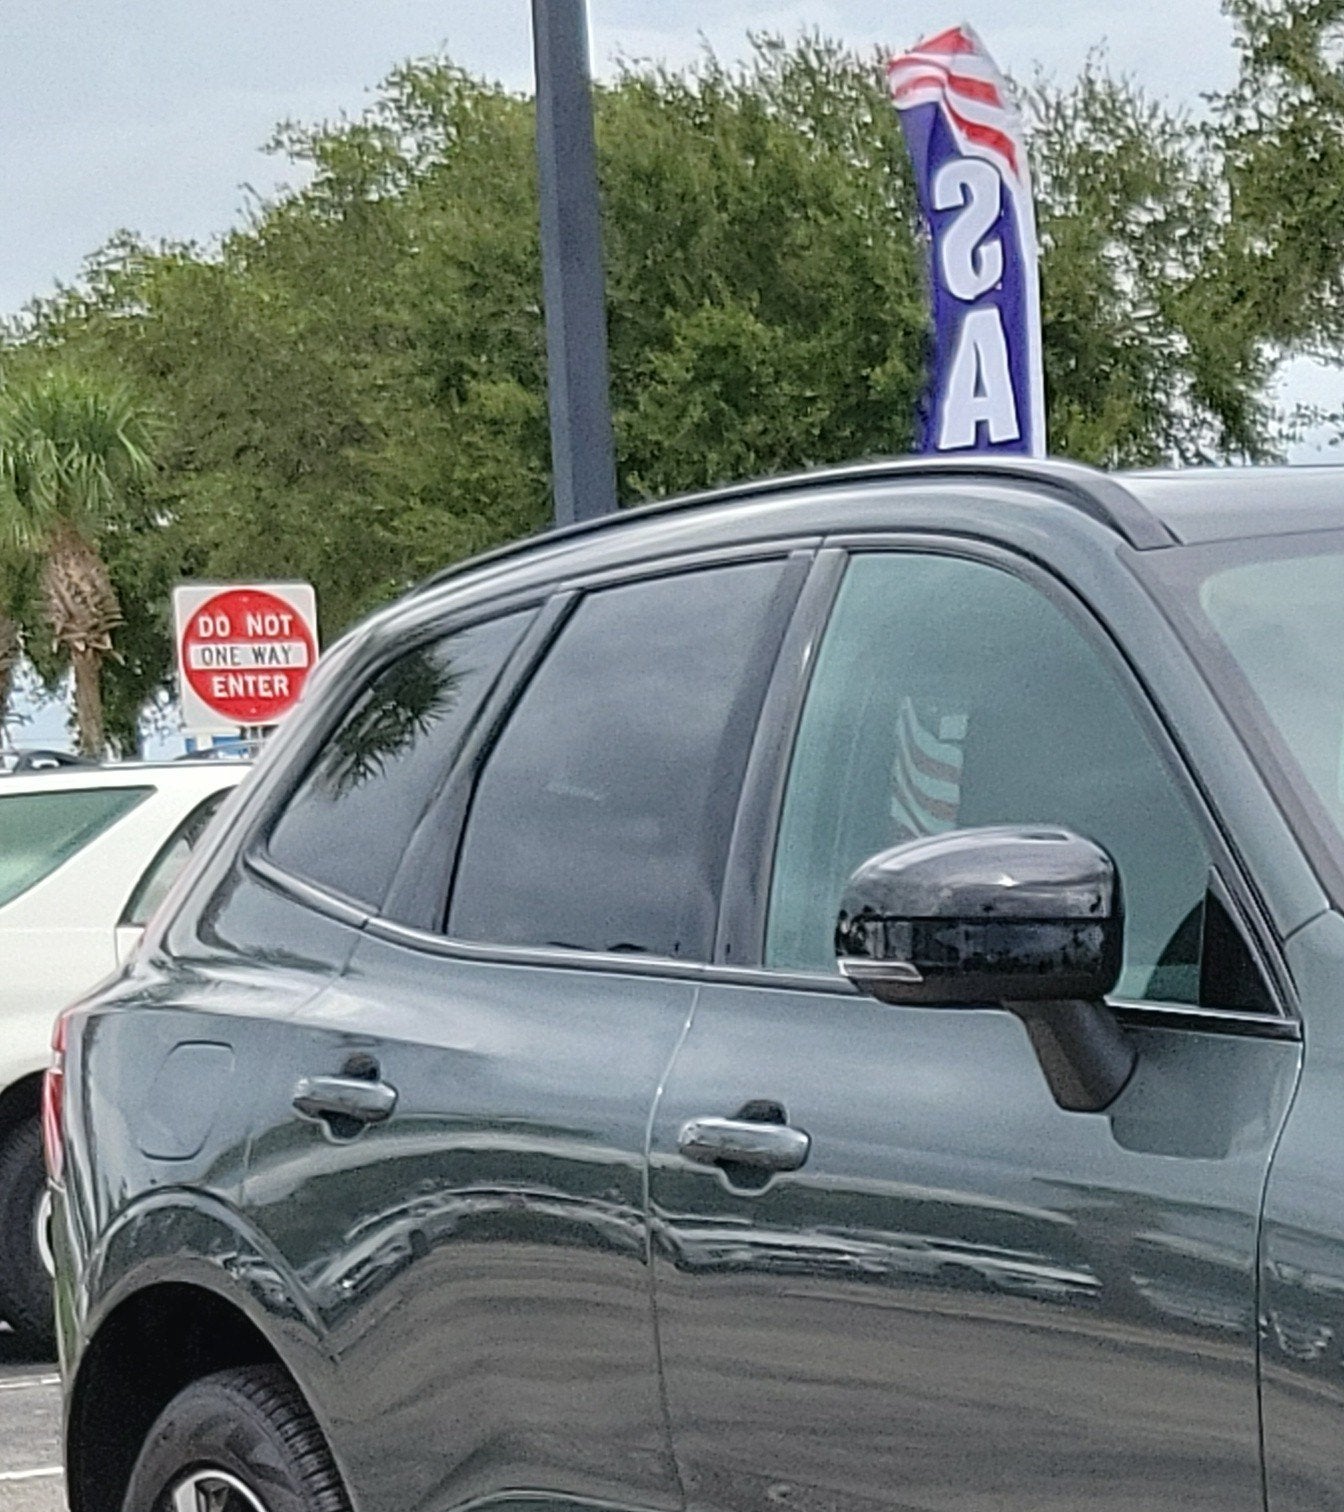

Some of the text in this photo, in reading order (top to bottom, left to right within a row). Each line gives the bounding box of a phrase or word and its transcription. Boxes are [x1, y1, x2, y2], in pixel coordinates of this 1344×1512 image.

[198, 613, 293, 638] DO NOT
[201, 645, 292, 666] ONE WAY
[212, 674, 289, 699] ENTER
